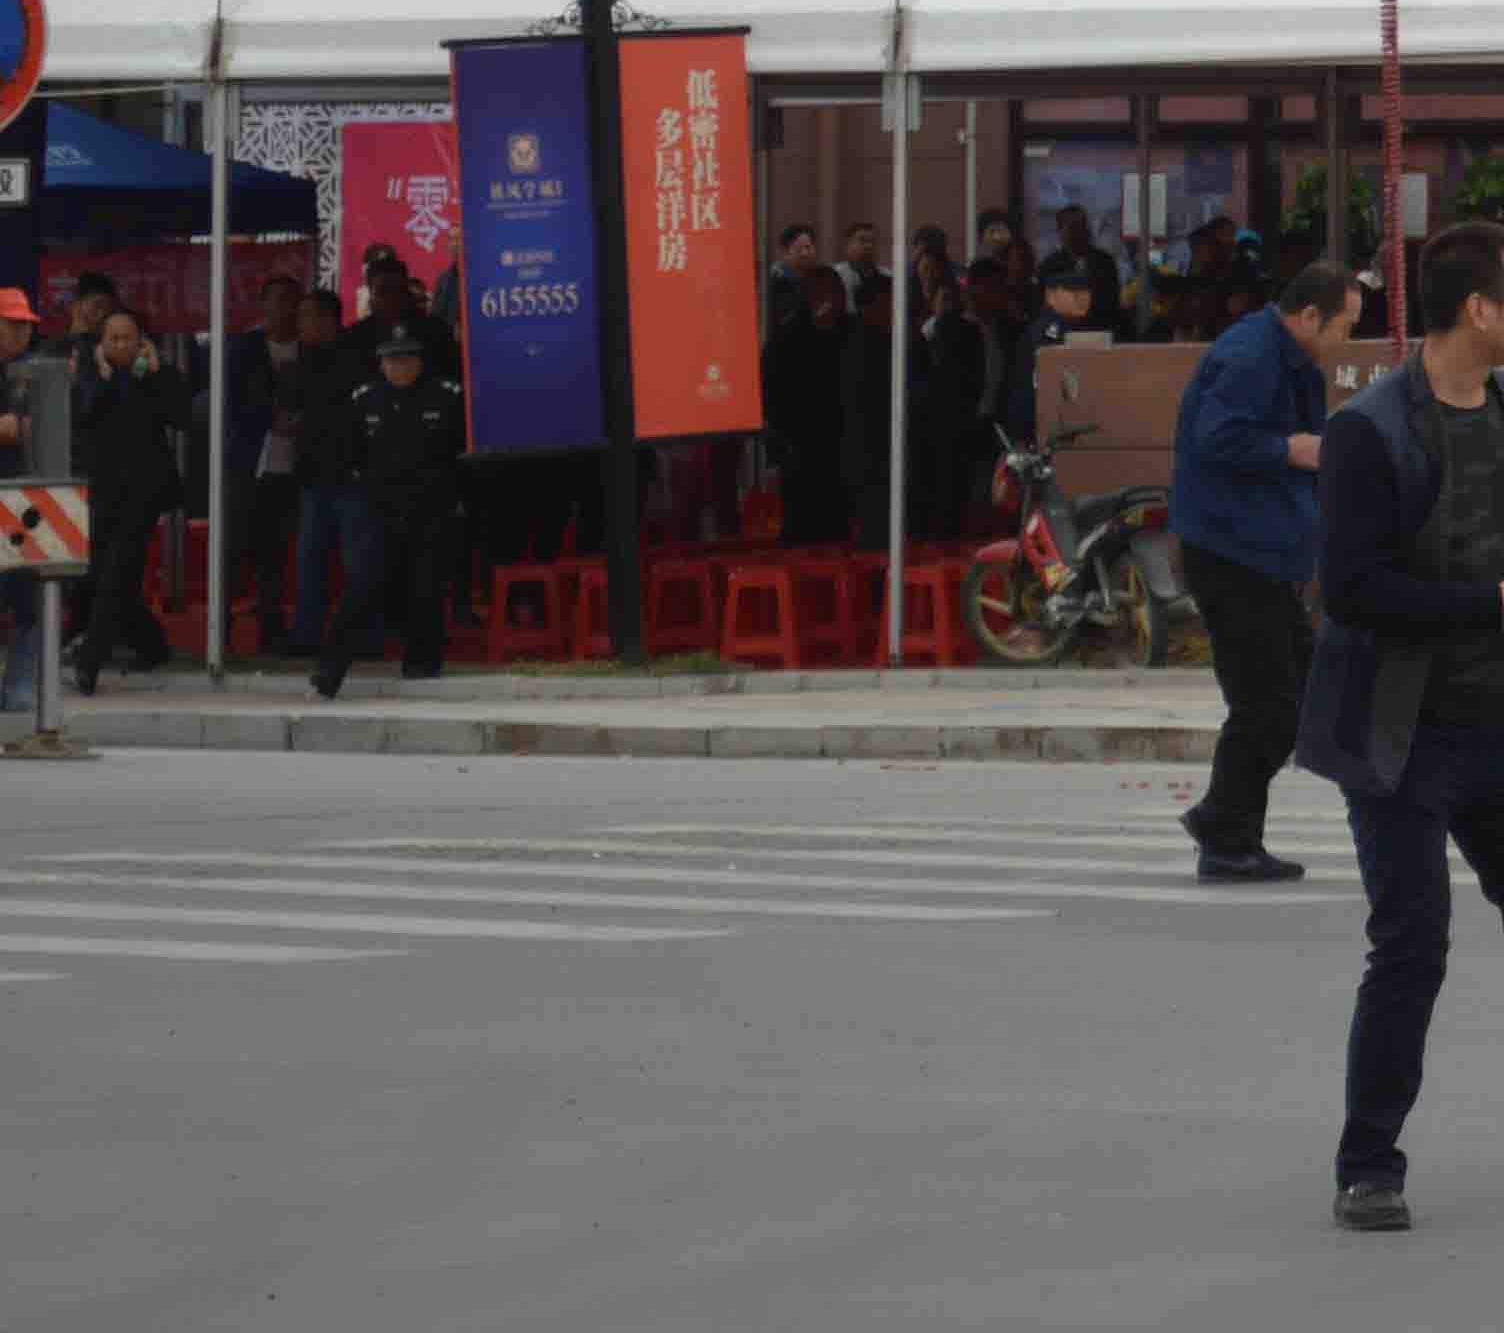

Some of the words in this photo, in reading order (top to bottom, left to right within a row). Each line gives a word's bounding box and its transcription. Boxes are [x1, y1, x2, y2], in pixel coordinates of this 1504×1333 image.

[656, 107, 688, 272] 多层洋房
[686, 69, 720, 230] 低密社区
[481, 284, 580, 318] 6155555
